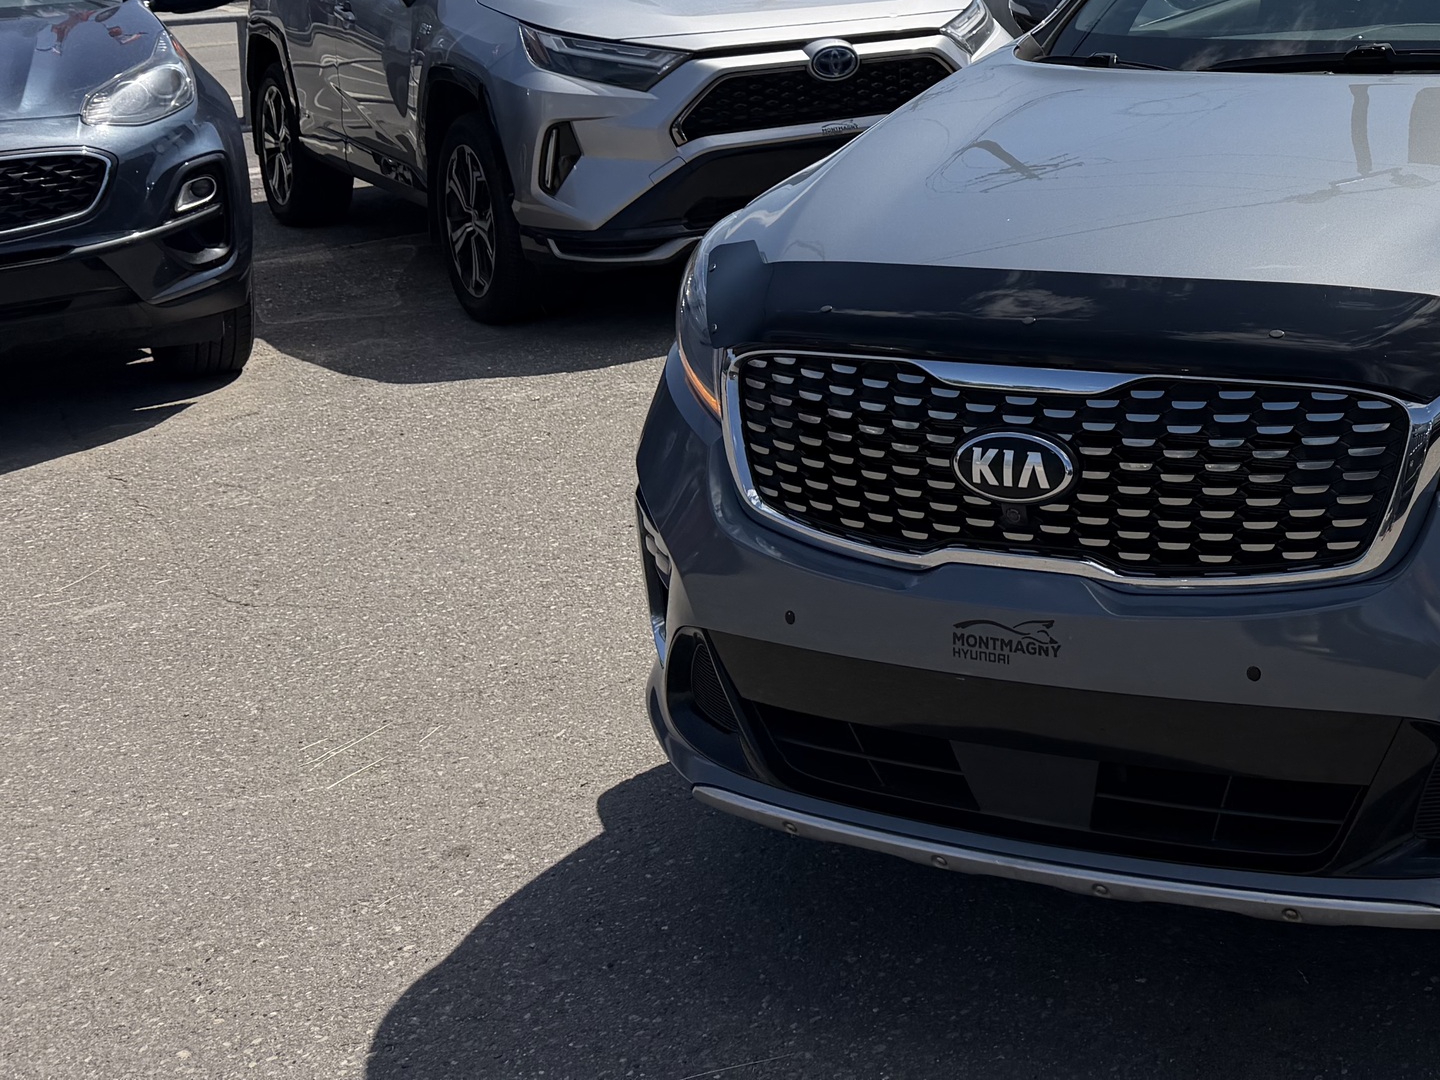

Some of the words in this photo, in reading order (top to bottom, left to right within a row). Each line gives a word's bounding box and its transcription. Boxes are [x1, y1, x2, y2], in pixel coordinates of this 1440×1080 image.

[972, 446, 1051, 489] KIA
[952, 631, 1062, 658] MONTMAGNY
[952, 646, 1010, 665] HYUNDAI
